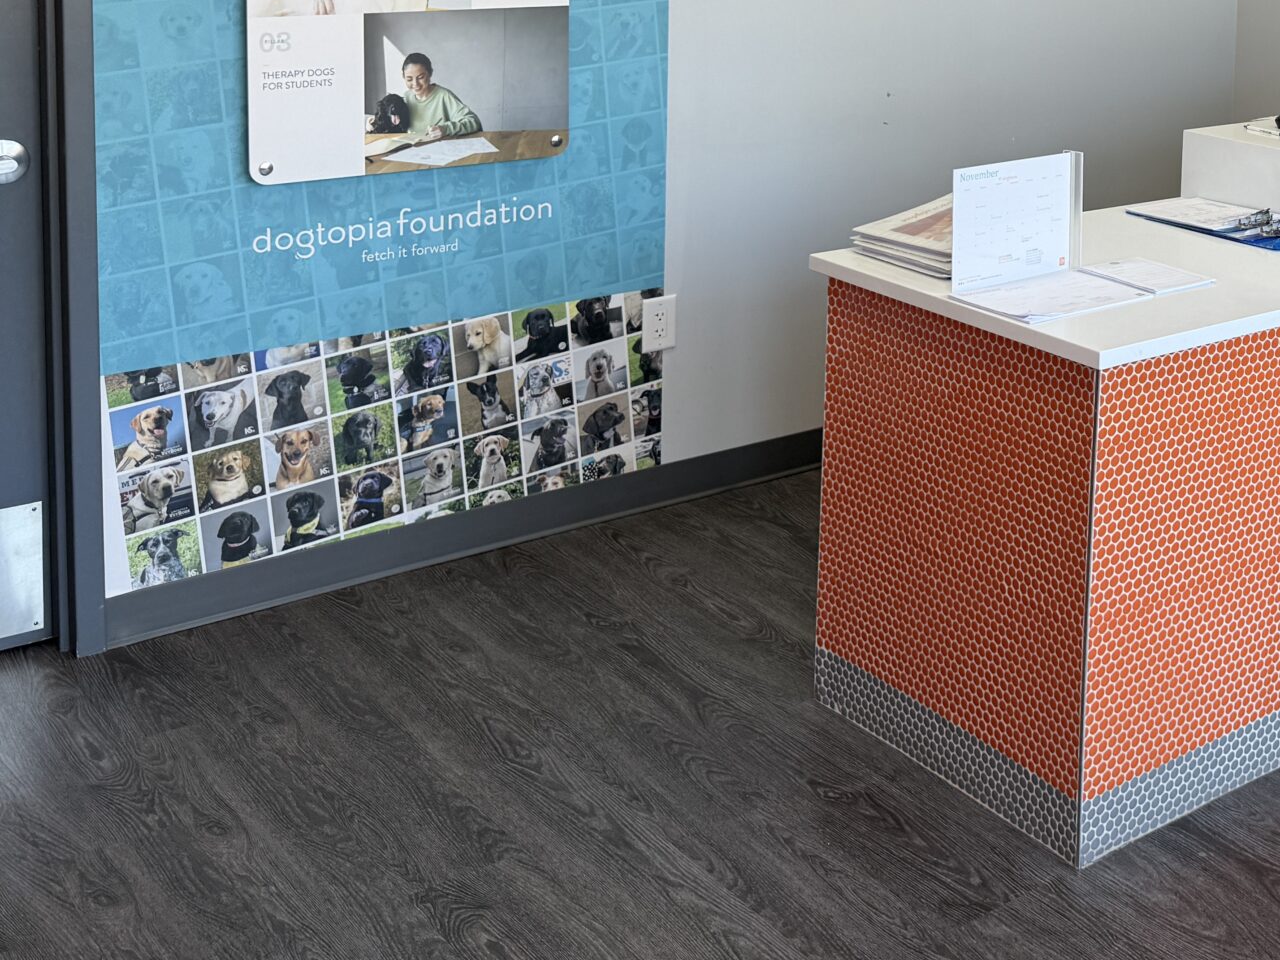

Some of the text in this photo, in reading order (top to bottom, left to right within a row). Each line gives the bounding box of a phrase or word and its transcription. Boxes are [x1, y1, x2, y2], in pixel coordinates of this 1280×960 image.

[260, 31, 291, 53] 03
[262, 67, 335, 80] THERAPY DOGS
[262, 79, 333, 91] FOR STUDENTS
[960, 169, 1000, 183] November
[361, 238, 459, 263] fetch it forward
